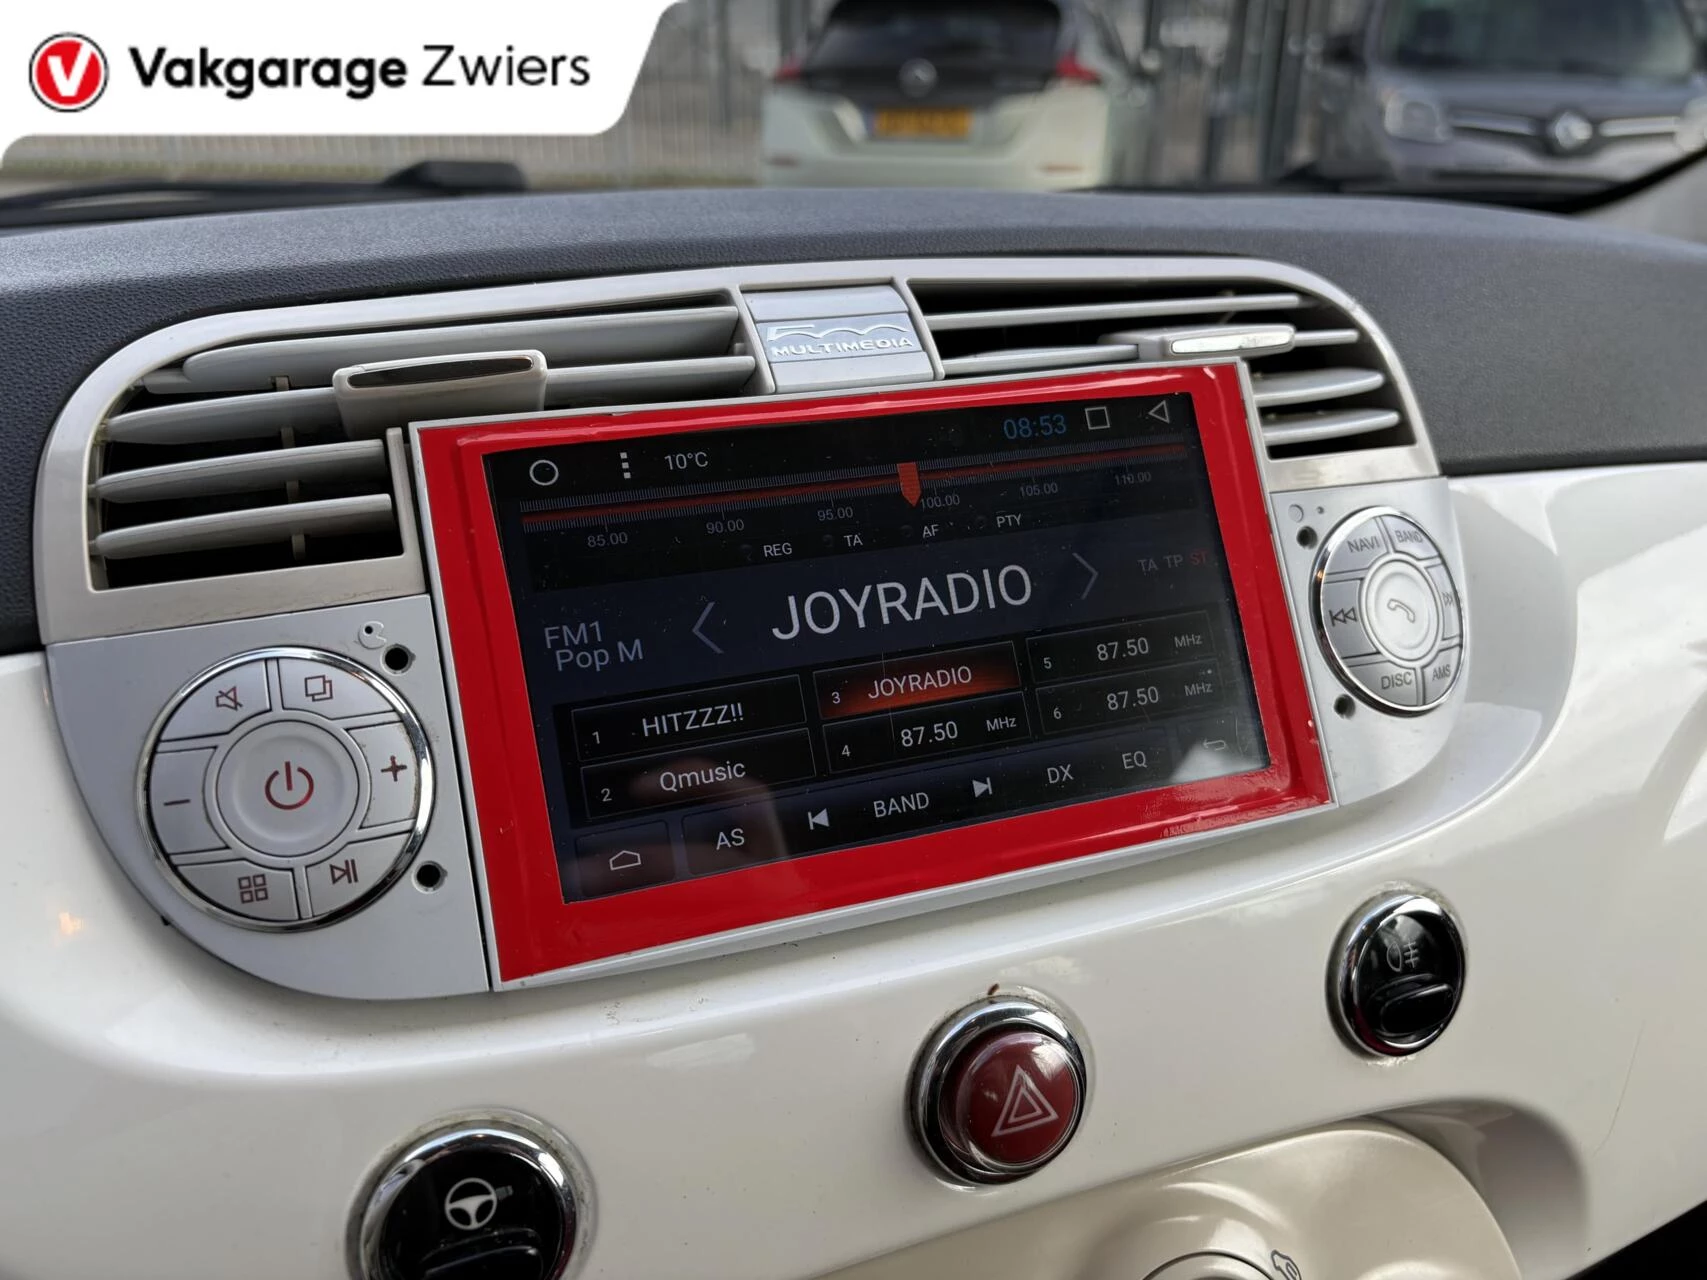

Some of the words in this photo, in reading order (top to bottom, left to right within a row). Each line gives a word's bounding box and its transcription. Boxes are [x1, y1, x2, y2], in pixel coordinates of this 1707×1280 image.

[771, 337, 914, 357] MULTIMEDIA
[1003, 413, 1067, 440] 08:53
[664, 451, 709, 471] 10°C
[587, 531, 629, 548] 85.00
[706, 518, 745, 534] 90.00
[817, 506, 854, 522] 95.00
[920, 493, 961, 512] 100.00
[1019, 482, 1059, 498] 105.00
[1114, 471, 1152, 486] 110.00
[763, 542, 793, 558] REG
[844, 533, 864, 548] TA
[922, 523, 940, 539] AF
[996, 513, 1022, 528] PTY
[1346, 535, 1382, 554] NAVI
[1395, 529, 1424, 545] BAND
[1137, 558, 1158, 573] TA
[1163, 554, 1184, 569] TP
[771, 564, 1032, 640] JOYRADIO
[544, 620, 603, 649] FM1
[555, 648, 610, 672] Pop
[617, 638, 644, 664] M
[1043, 656, 1052, 670] 5
[1096, 637, 1150, 662] 87.50
[1174, 633, 1203, 649] MHz
[831, 691, 841, 704] 3
[867, 665, 973, 700] JOYRADIO
[1380, 671, 1414, 691] DISC
[1431, 663, 1452, 682] AMS
[1053, 707, 1062, 720] 6
[1106, 685, 1160, 711] 87.50
[1184, 681, 1213, 697] MHz
[592, 731, 601, 745] 1
[641, 702, 745, 737] HITZZZ!!
[841, 745, 851, 758] 4
[900, 720, 959, 748] 87.50
[986, 715, 1017, 732] MHz
[1046, 763, 1075, 785] DX
[1121, 750, 1149, 770] EQ
[601, 788, 613, 802] 2
[659, 760, 747, 793] Qmusic
[873, 791, 930, 819] BAND
[716, 828, 746, 851] AS
